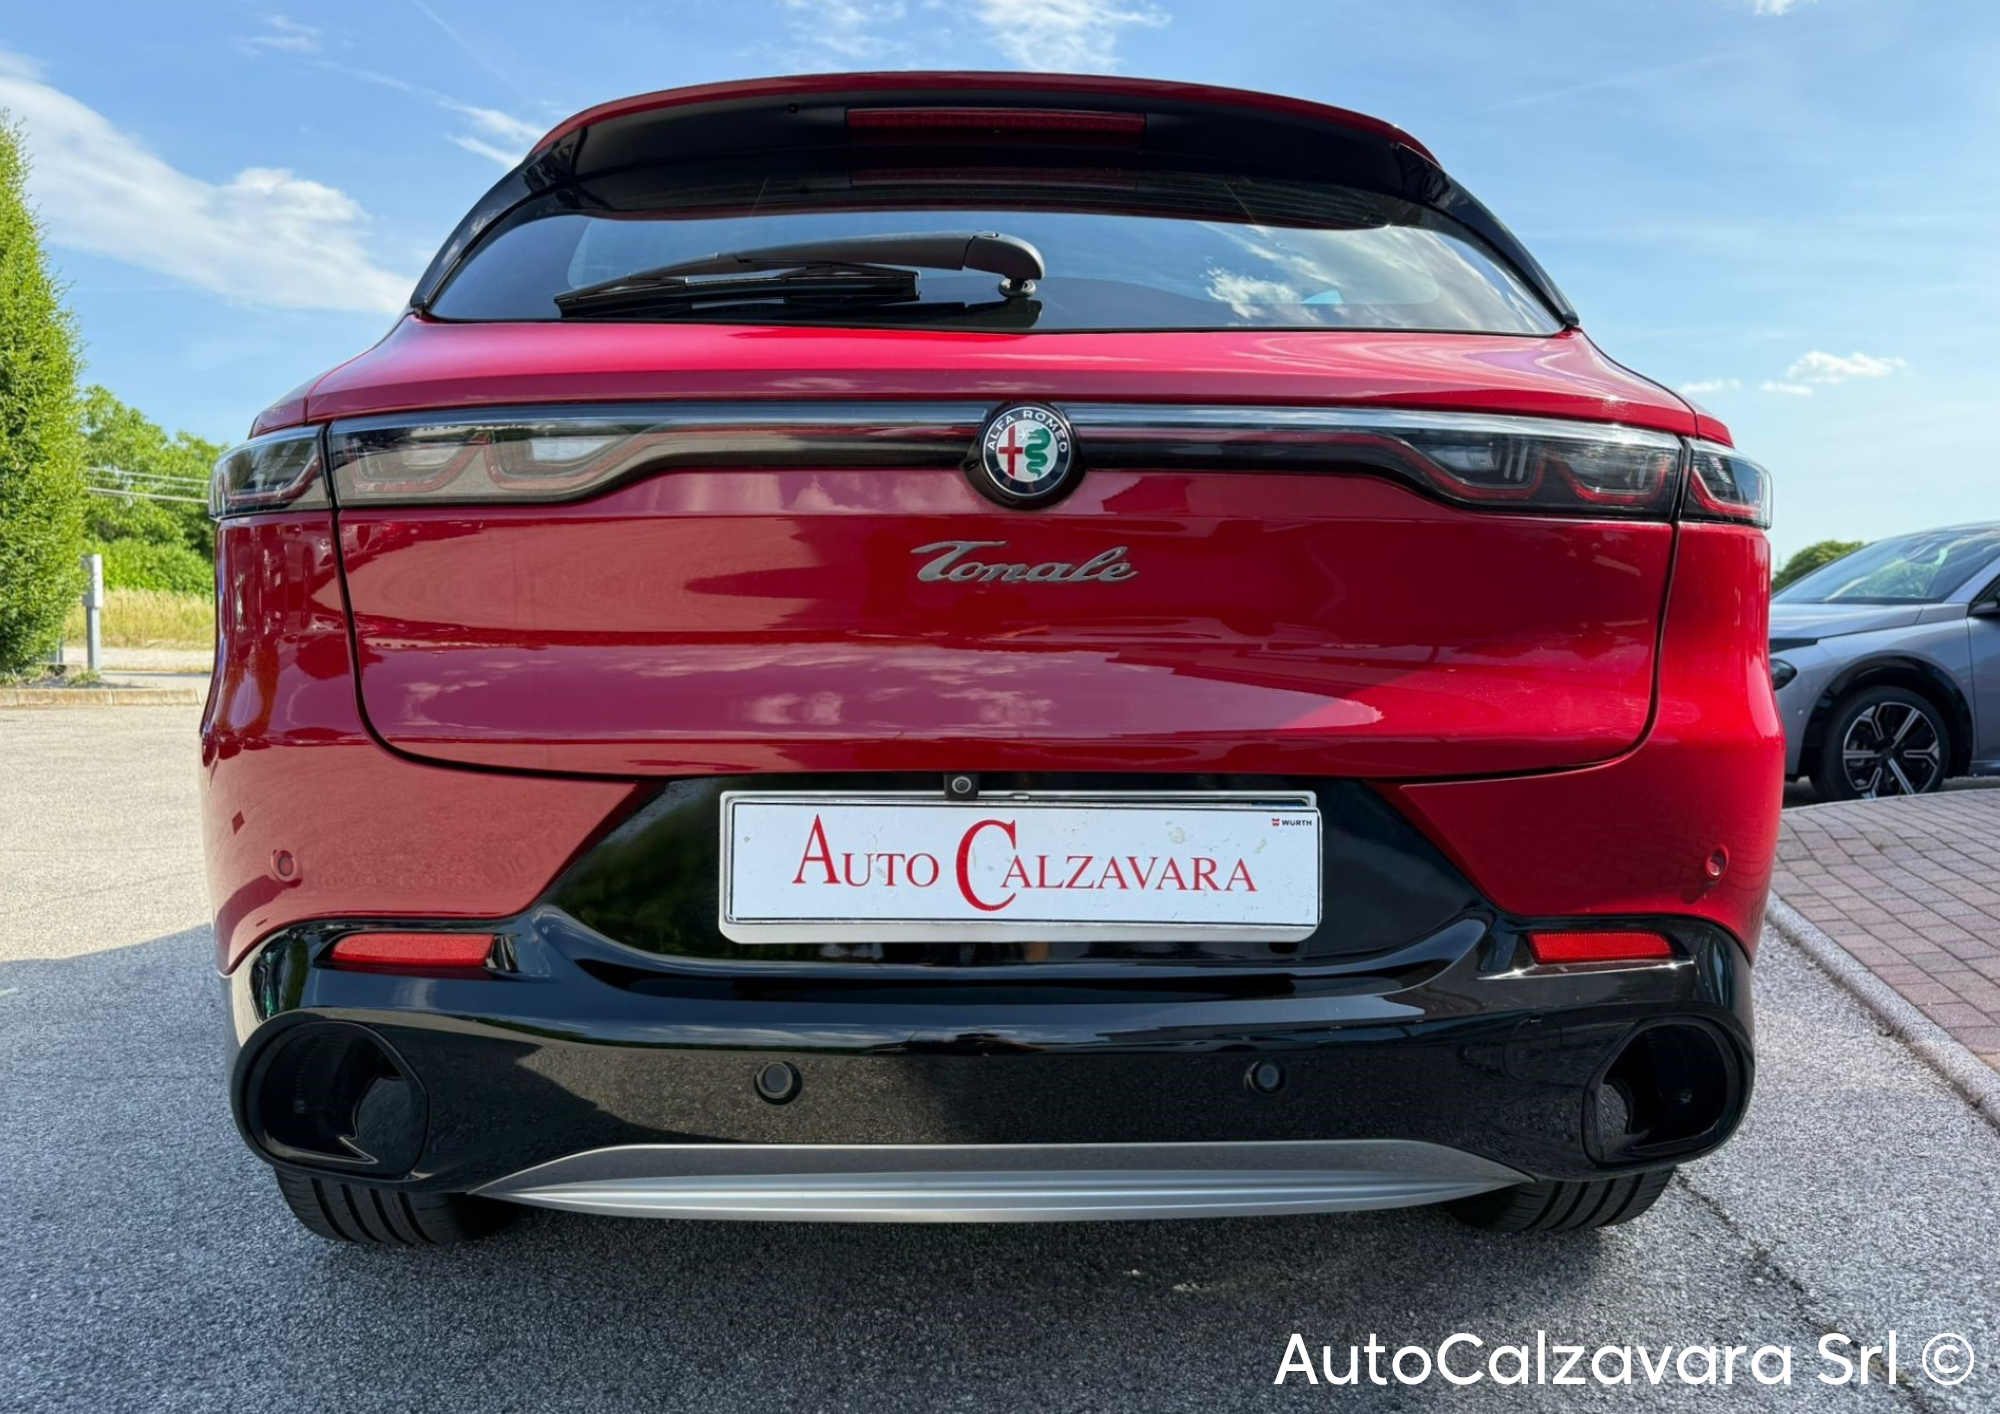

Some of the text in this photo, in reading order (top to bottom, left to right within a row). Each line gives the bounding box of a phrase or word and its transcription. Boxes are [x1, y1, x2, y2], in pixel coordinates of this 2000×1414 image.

[987, 410, 1068, 453] ALFA ROMEO
[910, 540, 1140, 583] Tonale
[792, 813, 1258, 912] AUTO CALZAVARA
